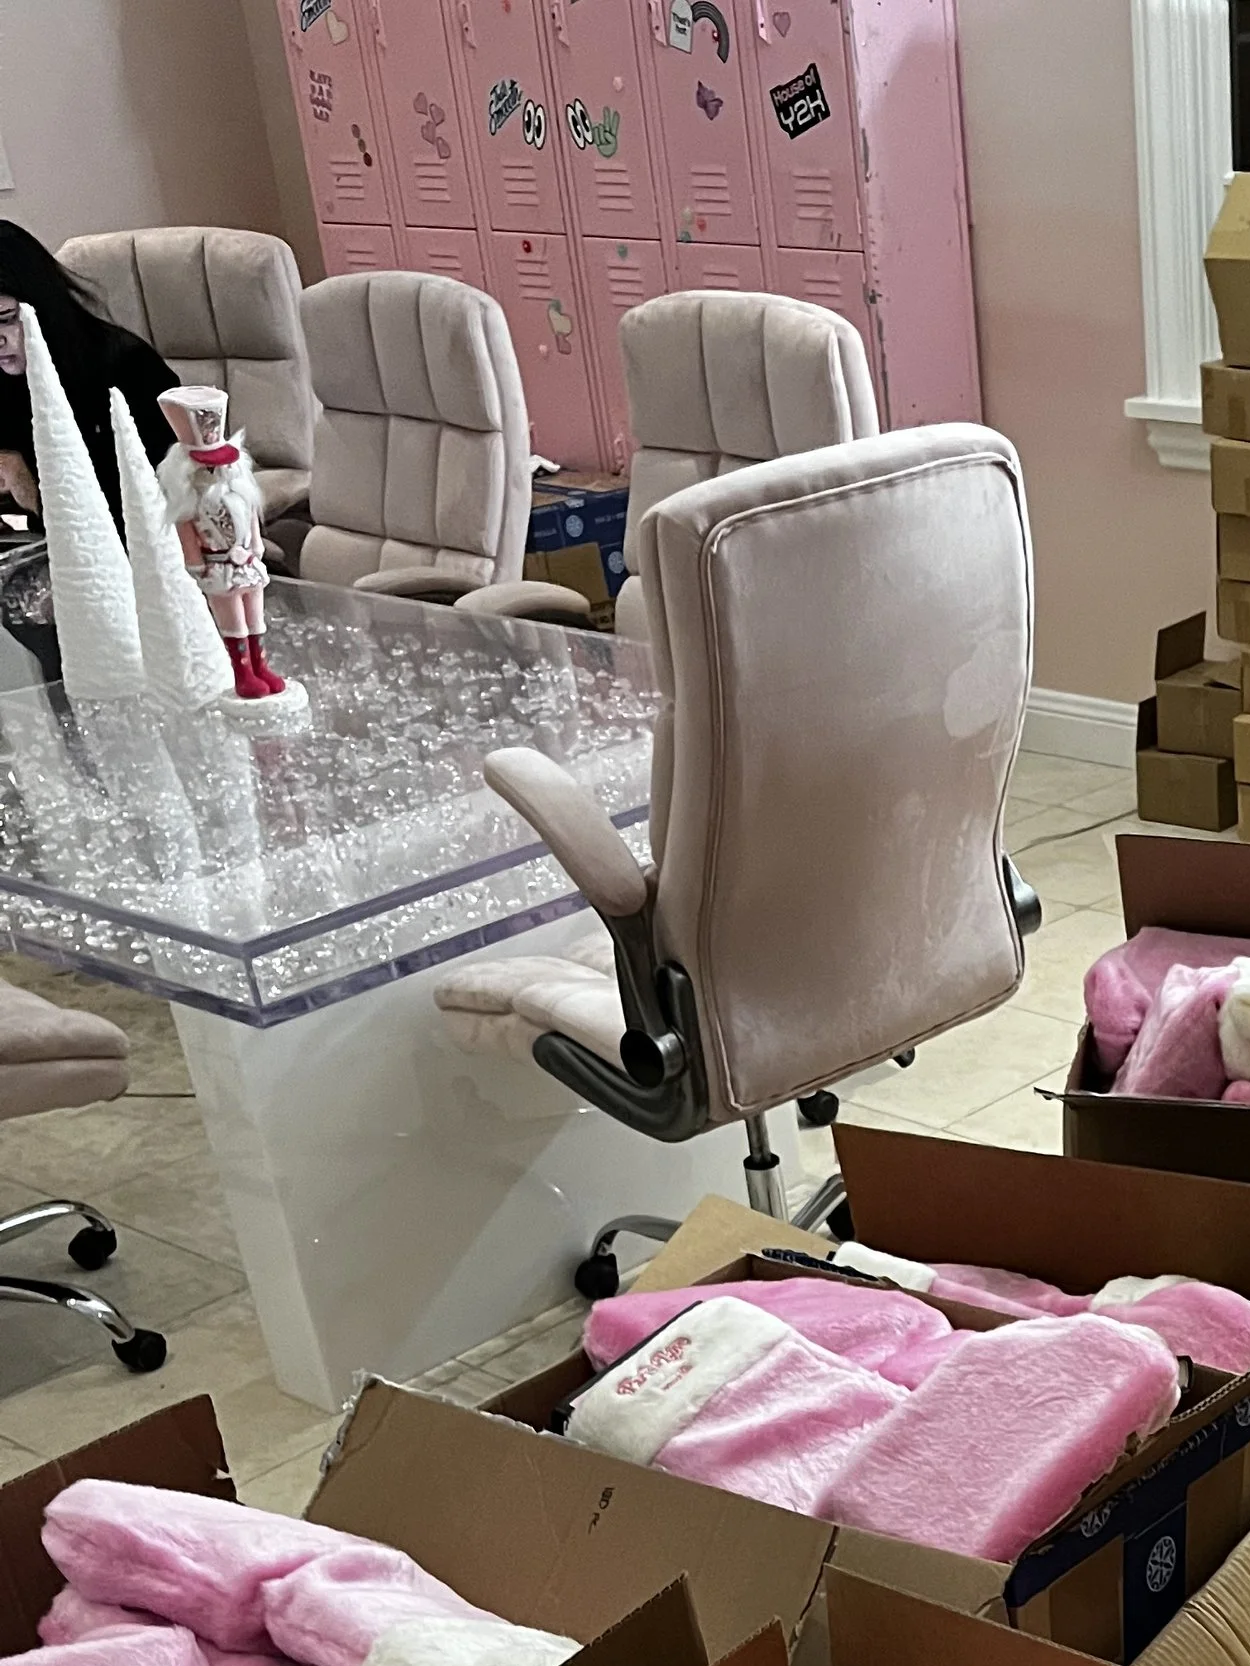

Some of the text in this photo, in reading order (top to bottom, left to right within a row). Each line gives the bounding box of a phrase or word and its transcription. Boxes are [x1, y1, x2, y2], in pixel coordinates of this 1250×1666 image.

[772, 68, 817, 107] House of
[780, 89, 826, 131] Y2K
